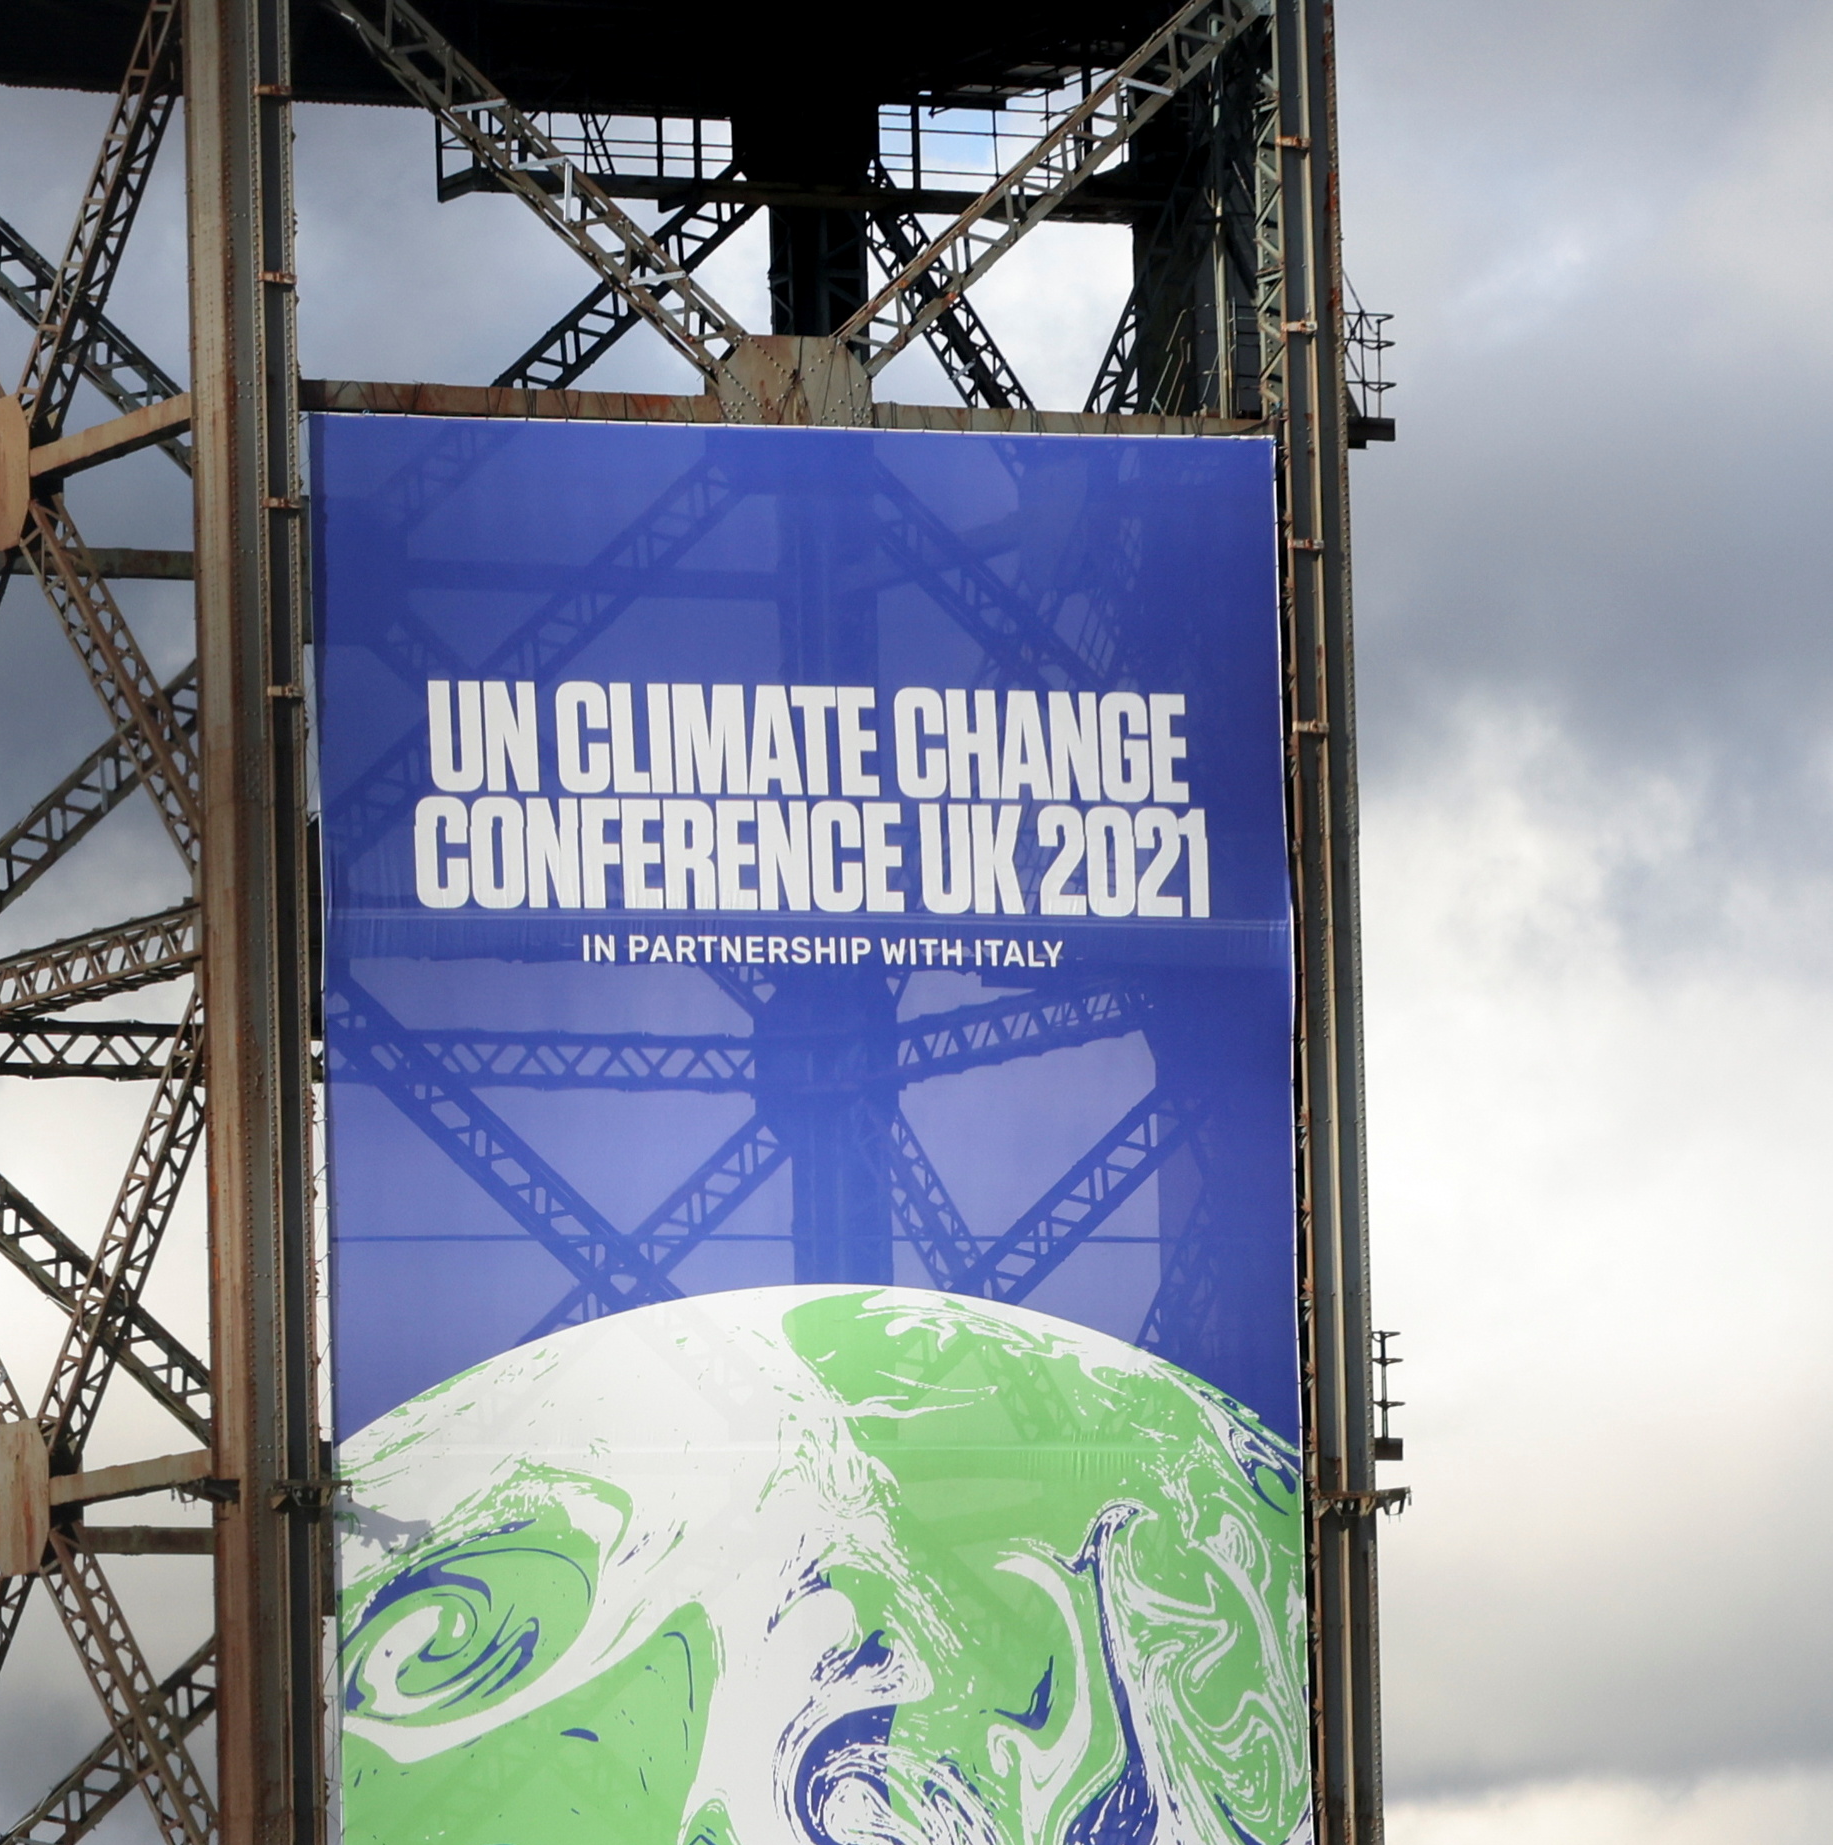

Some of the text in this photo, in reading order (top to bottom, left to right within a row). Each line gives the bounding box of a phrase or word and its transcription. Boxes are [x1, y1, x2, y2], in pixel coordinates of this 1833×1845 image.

[427, 680, 1189, 803] UN CLIMATE CHANGE
[414, 796, 1210, 918] CONFERENCE UK 2021
[582, 934, 1063, 968] IN PARTNERSHIP WITH ITALY
